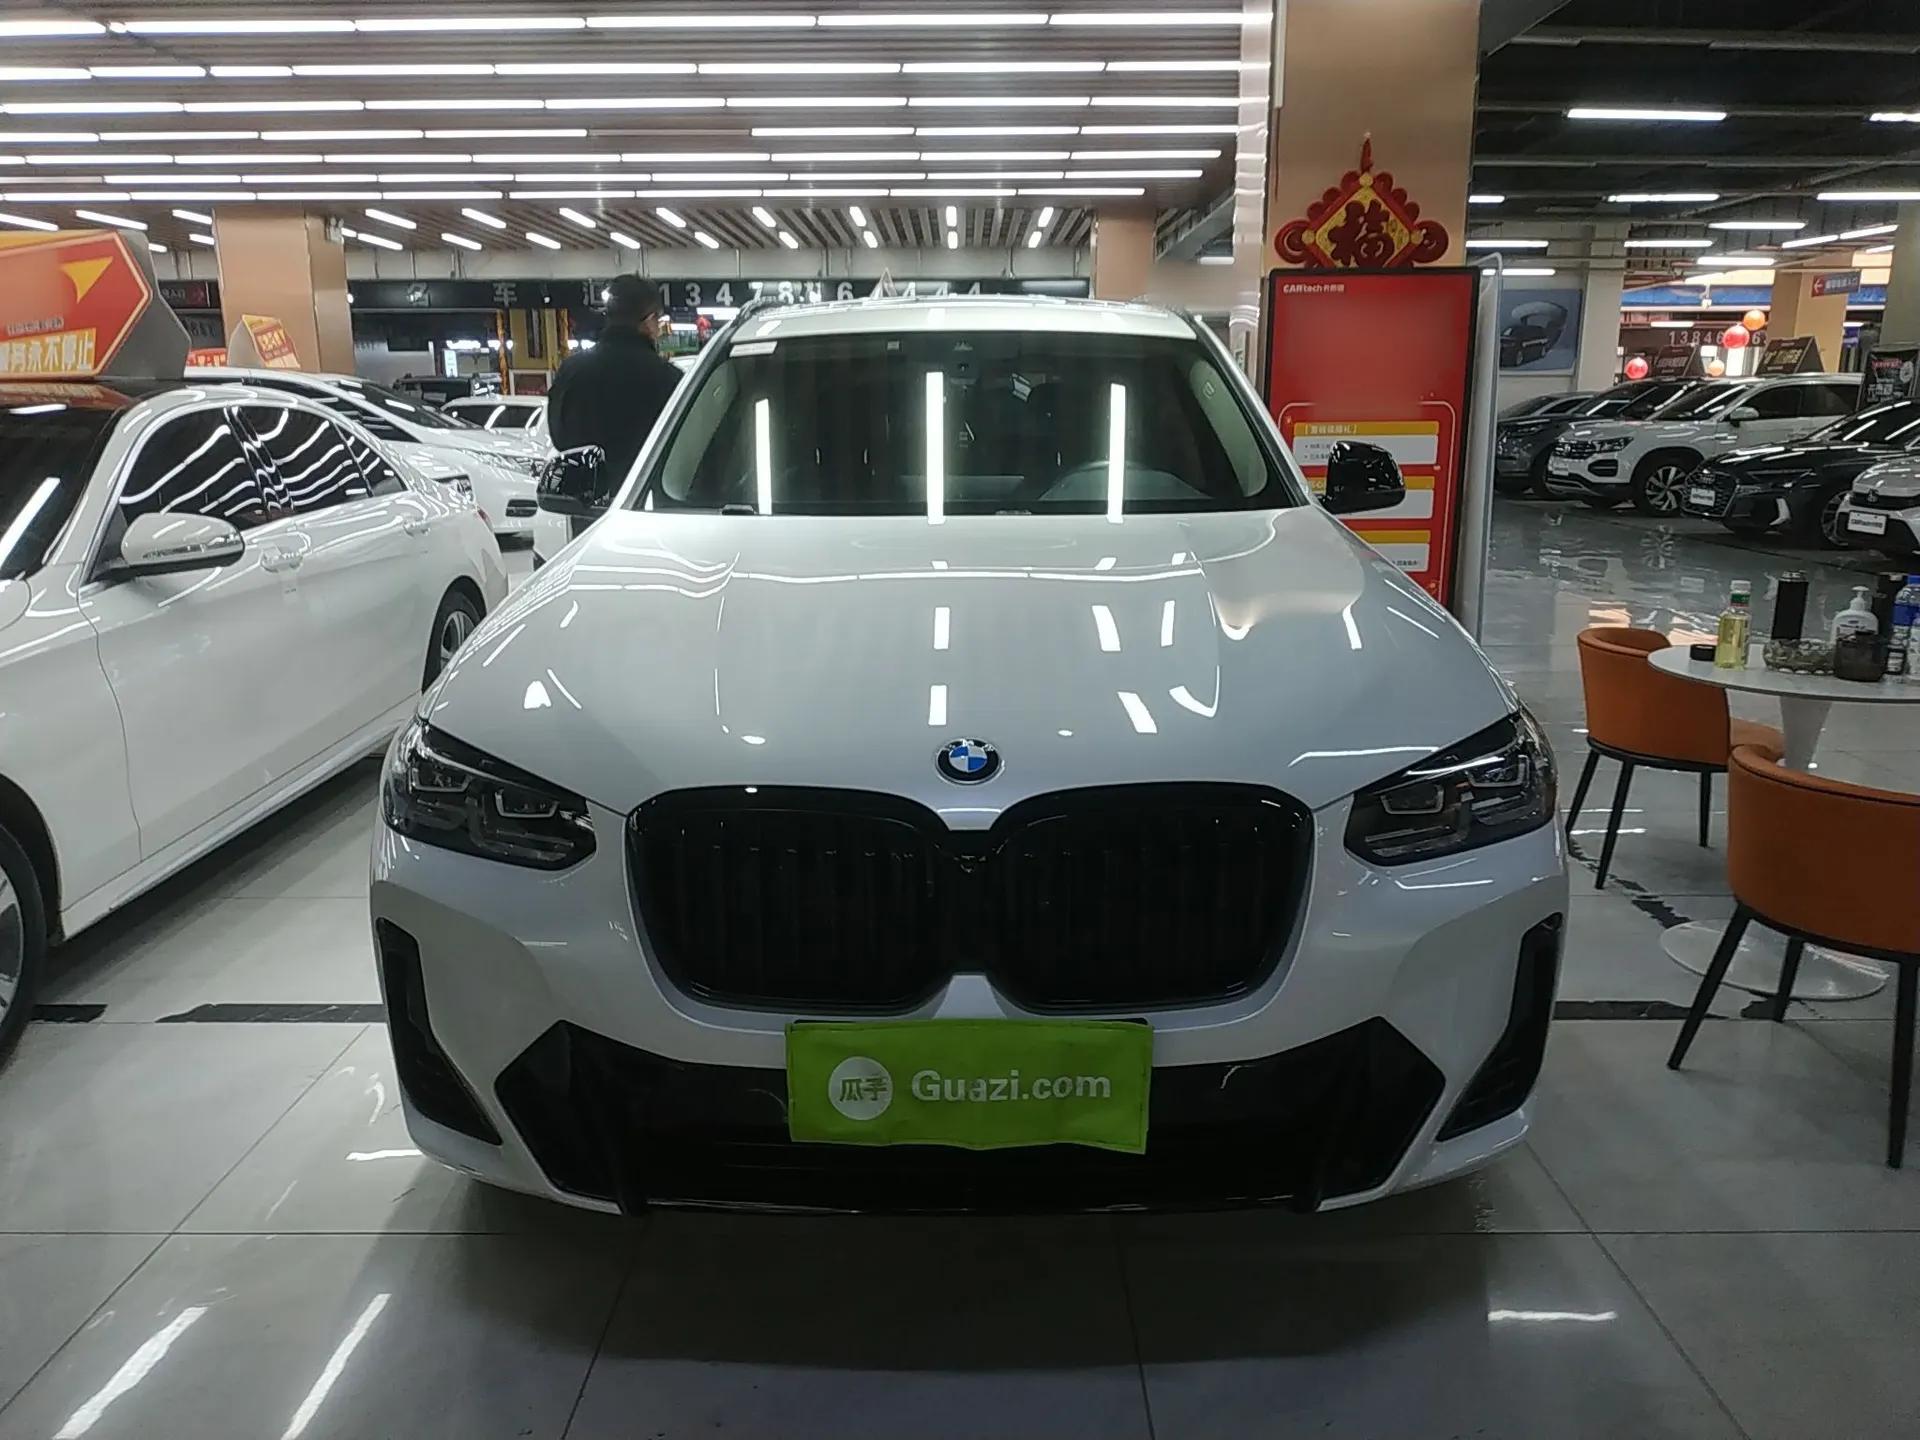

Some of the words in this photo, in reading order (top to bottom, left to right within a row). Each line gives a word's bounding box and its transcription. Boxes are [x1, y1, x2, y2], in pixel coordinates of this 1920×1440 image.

[1327, 199, 1395, 267] 福
[839, 1073, 890, 1102] 瓜子
[911, 1069, 1111, 1101] Guazi.com
